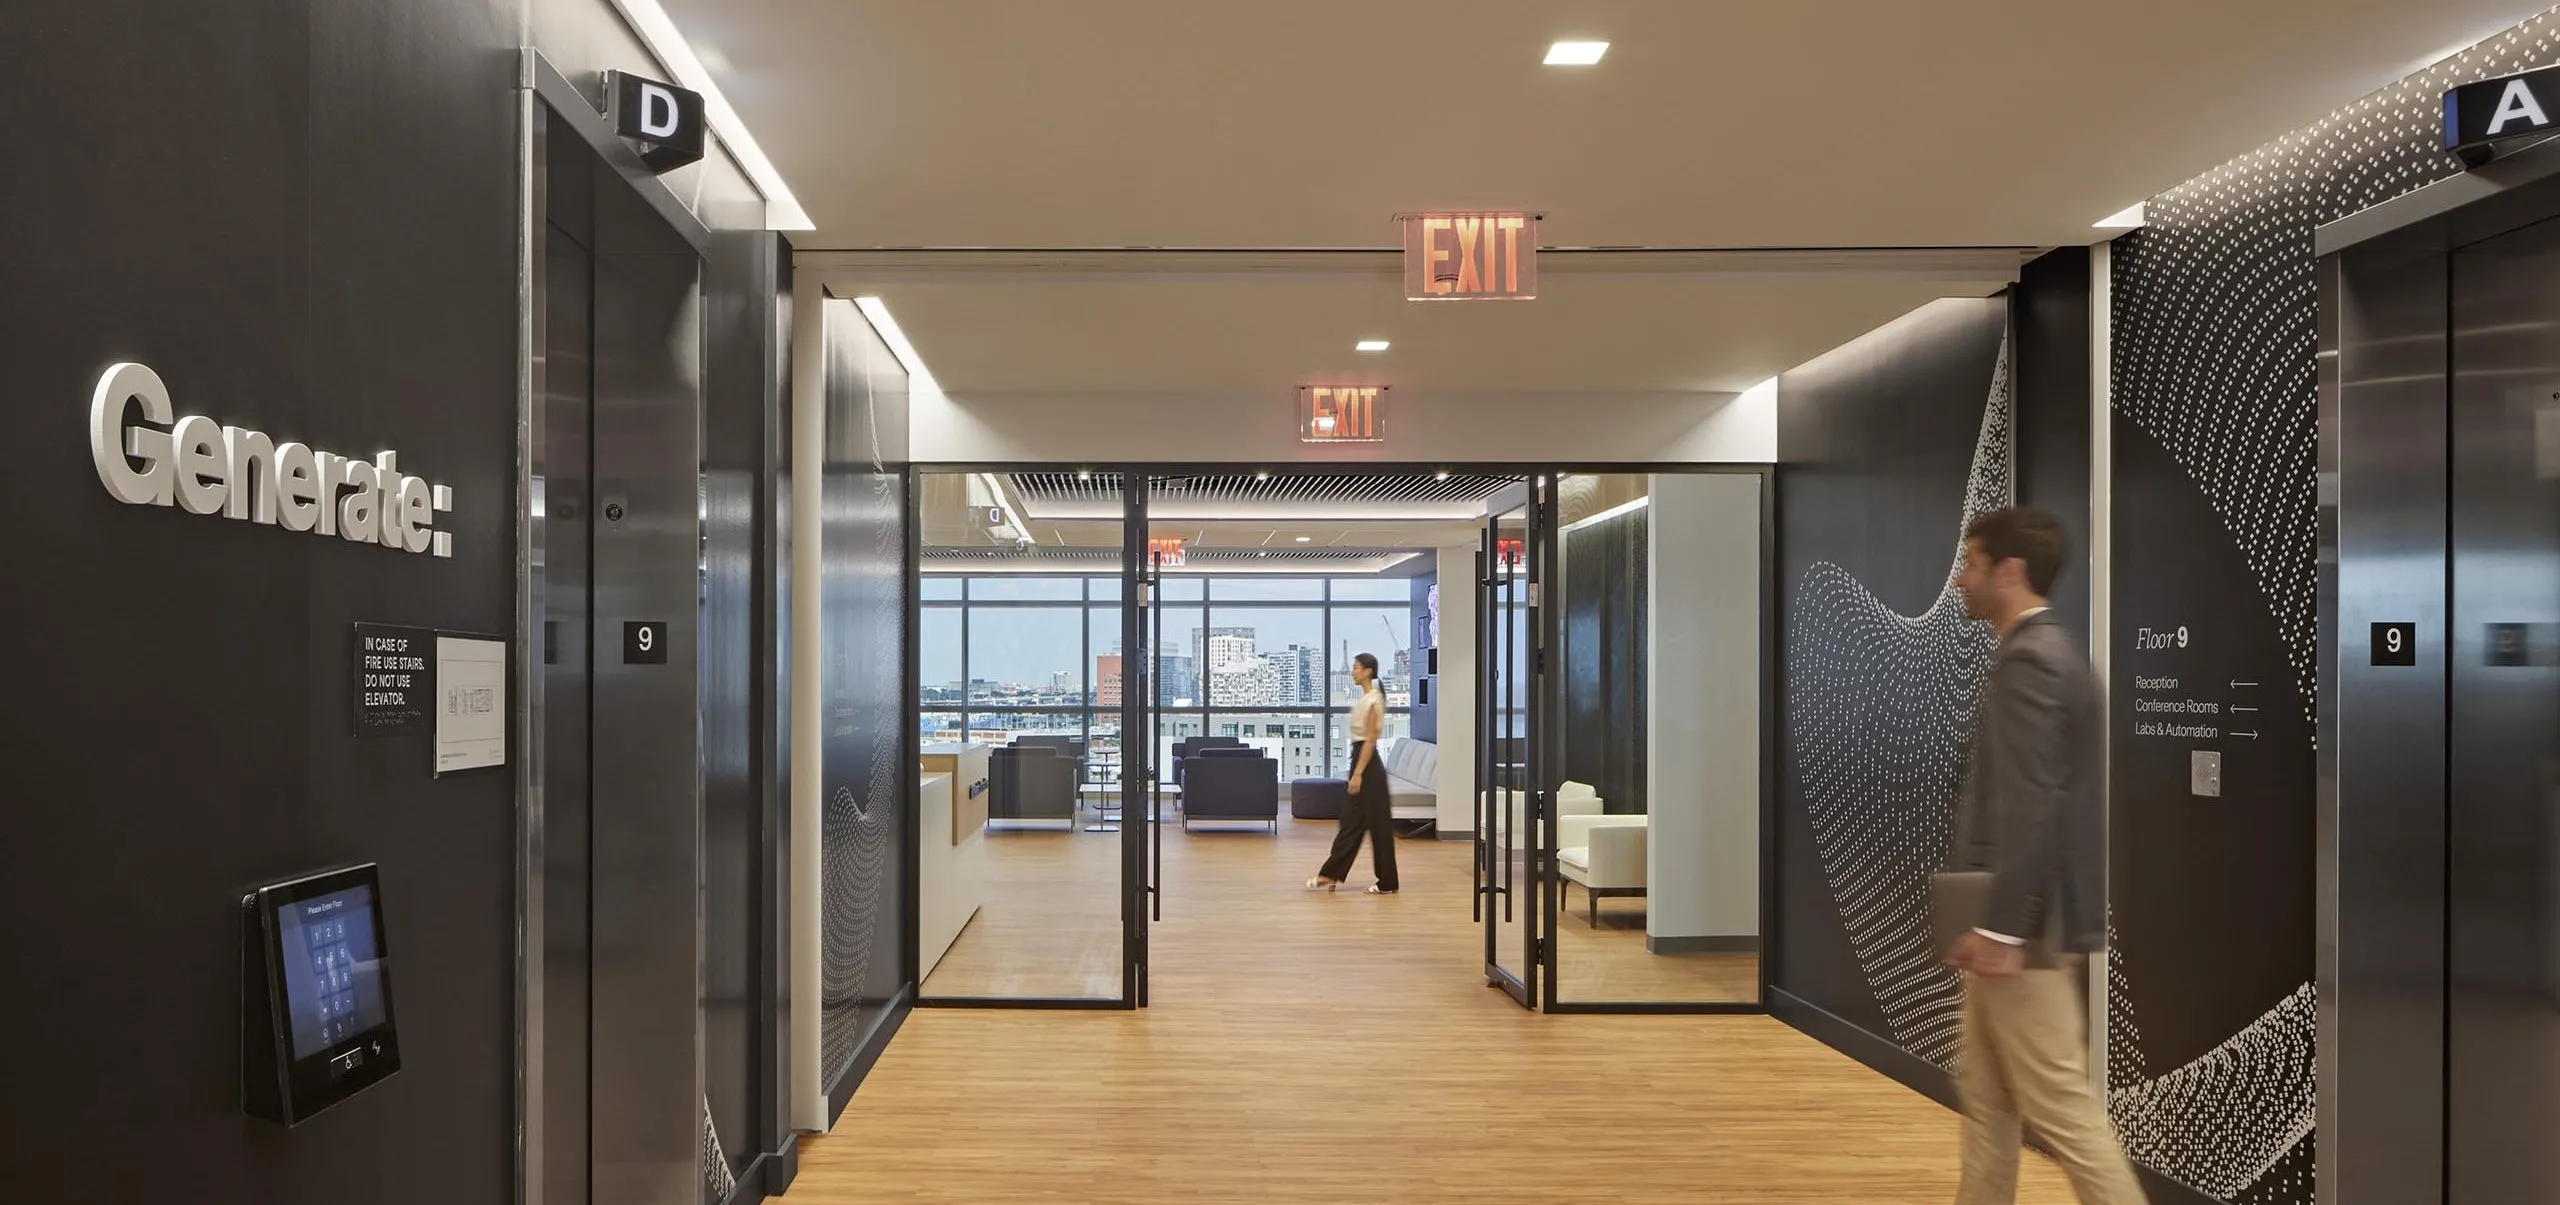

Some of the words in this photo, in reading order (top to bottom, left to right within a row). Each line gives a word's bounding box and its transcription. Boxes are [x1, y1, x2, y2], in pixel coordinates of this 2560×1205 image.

[641, 83, 679, 137] D
[2486, 79, 2550, 135] A
[1423, 217, 1524, 293] EXIT
[1312, 387, 1377, 437] EXIT
[91, 362, 453, 558] Generate:
[365, 637, 374, 651] IN
[375, 637, 395, 652] CASE
[397, 639, 408, 652] OF
[638, 626, 653, 651] 9
[2135, 627, 2175, 650] Floor
[2177, 626, 2188, 648] 9
[2386, 627, 2402, 653] 9
[365, 655, 382, 669] FIRE
[383, 656, 398, 670] USE
[399, 656, 425, 670] STAIRS.
[365, 674, 378, 687] DO
[379, 674, 395, 687] NOT
[396, 674, 411, 688] USE
[2135, 675, 2178, 691] Reception
[365, 692, 406, 706] ELEVATOR.
[2135, 698, 2186, 712] Conference
[2186, 699, 2219, 714] Rooms
[2135, 721, 2156, 736] Labs
[2157, 722, 2164, 736] &
[2165, 722, 2218, 738] Automation
[308, 905, 322, 915] Please
[322, 902, 333, 911] Enter
[326, 927, 331, 938] 2
